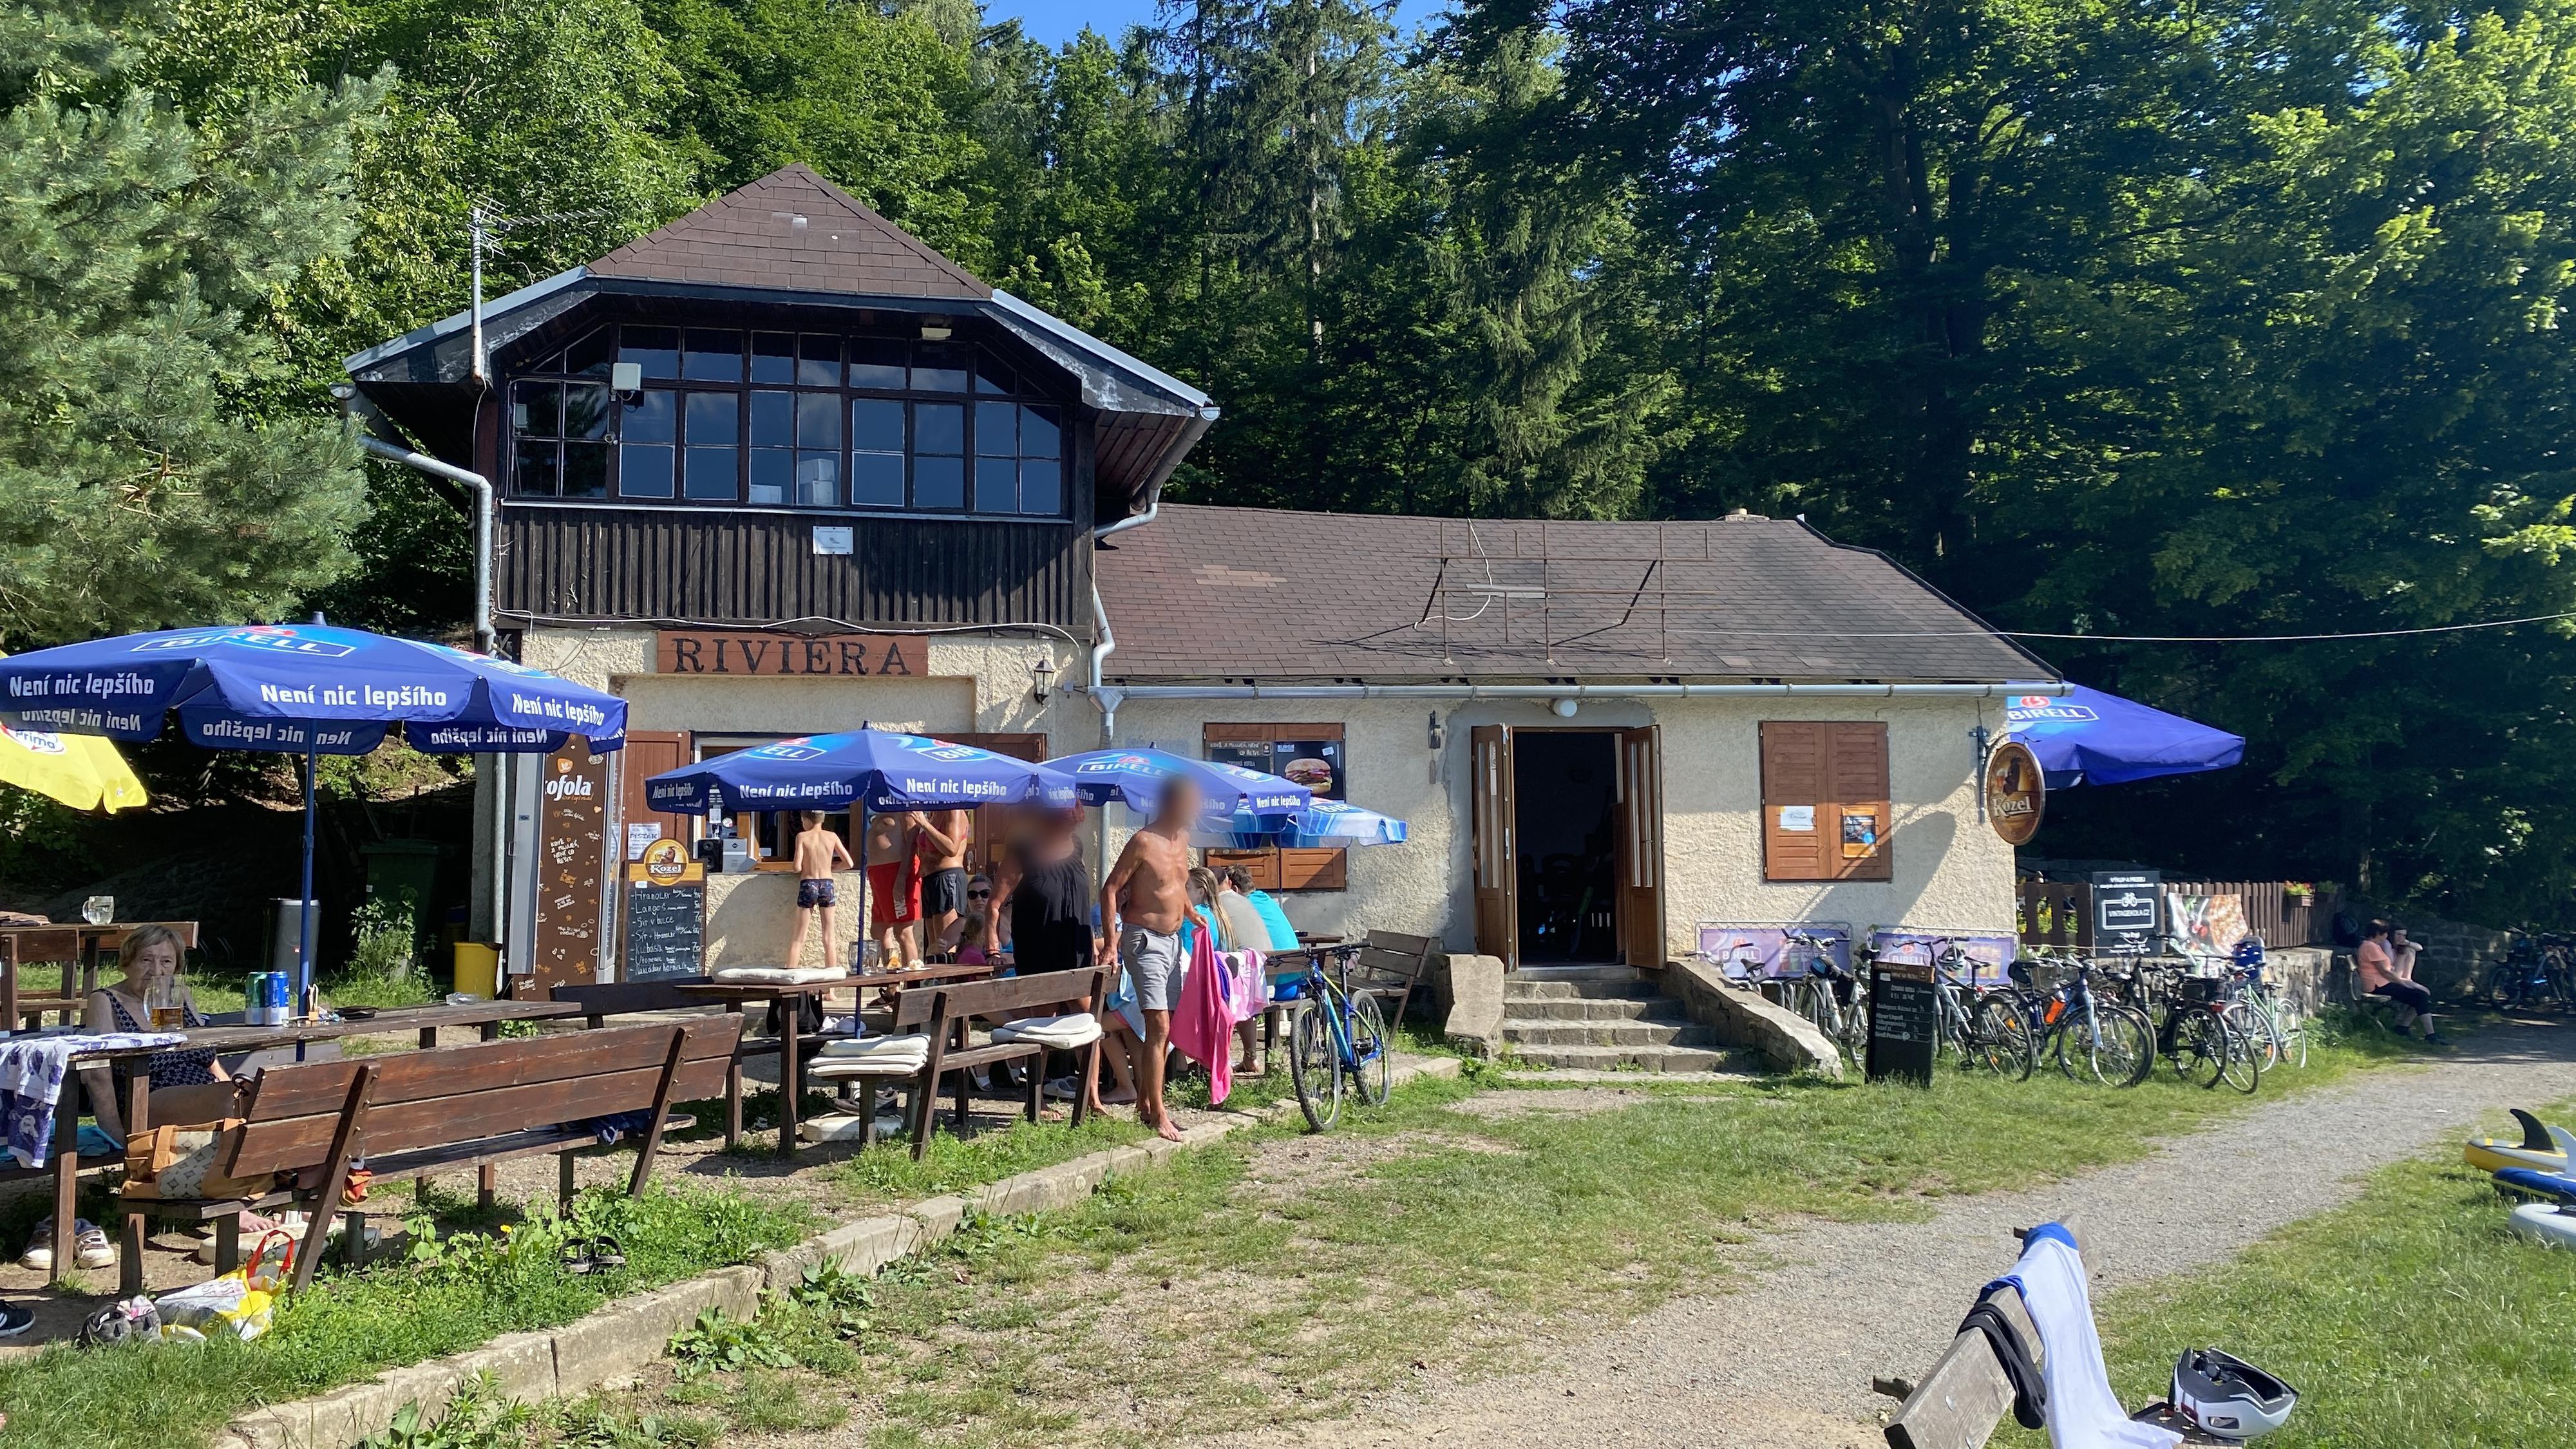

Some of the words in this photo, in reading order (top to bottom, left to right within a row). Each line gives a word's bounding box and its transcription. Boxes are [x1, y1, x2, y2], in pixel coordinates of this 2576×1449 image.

[672, 638, 911, 676] RIVIERA
[10, 674, 50, 697] Není
[55, 673, 82, 694] nic
[86, 672, 155, 699] lepšího
[260, 684, 316, 704] Není
[324, 684, 357, 705] nic
[365, 684, 447, 710] lepšího
[512, 693, 542, 715] Není
[544, 697, 562, 718] nic
[565, 699, 605, 726] lepšího
[2008, 708, 2087, 720] BIRELL
[545, 775, 591, 801] ofola
[739, 784, 773, 799] Není
[776, 784, 797, 799] nic
[800, 781, 853, 799] lepšího
[906, 778, 936, 793] Není
[941, 779, 960, 793] nic
[963, 779, 1007, 797] lepšího
[1256, 797, 1270, 809] Není
[1280, 795, 1301, 808] lepšího
[1993, 796, 2033, 817] Kozel
[650, 864, 681, 874] Kozel
[1723, 951, 1757, 960] BRELL
